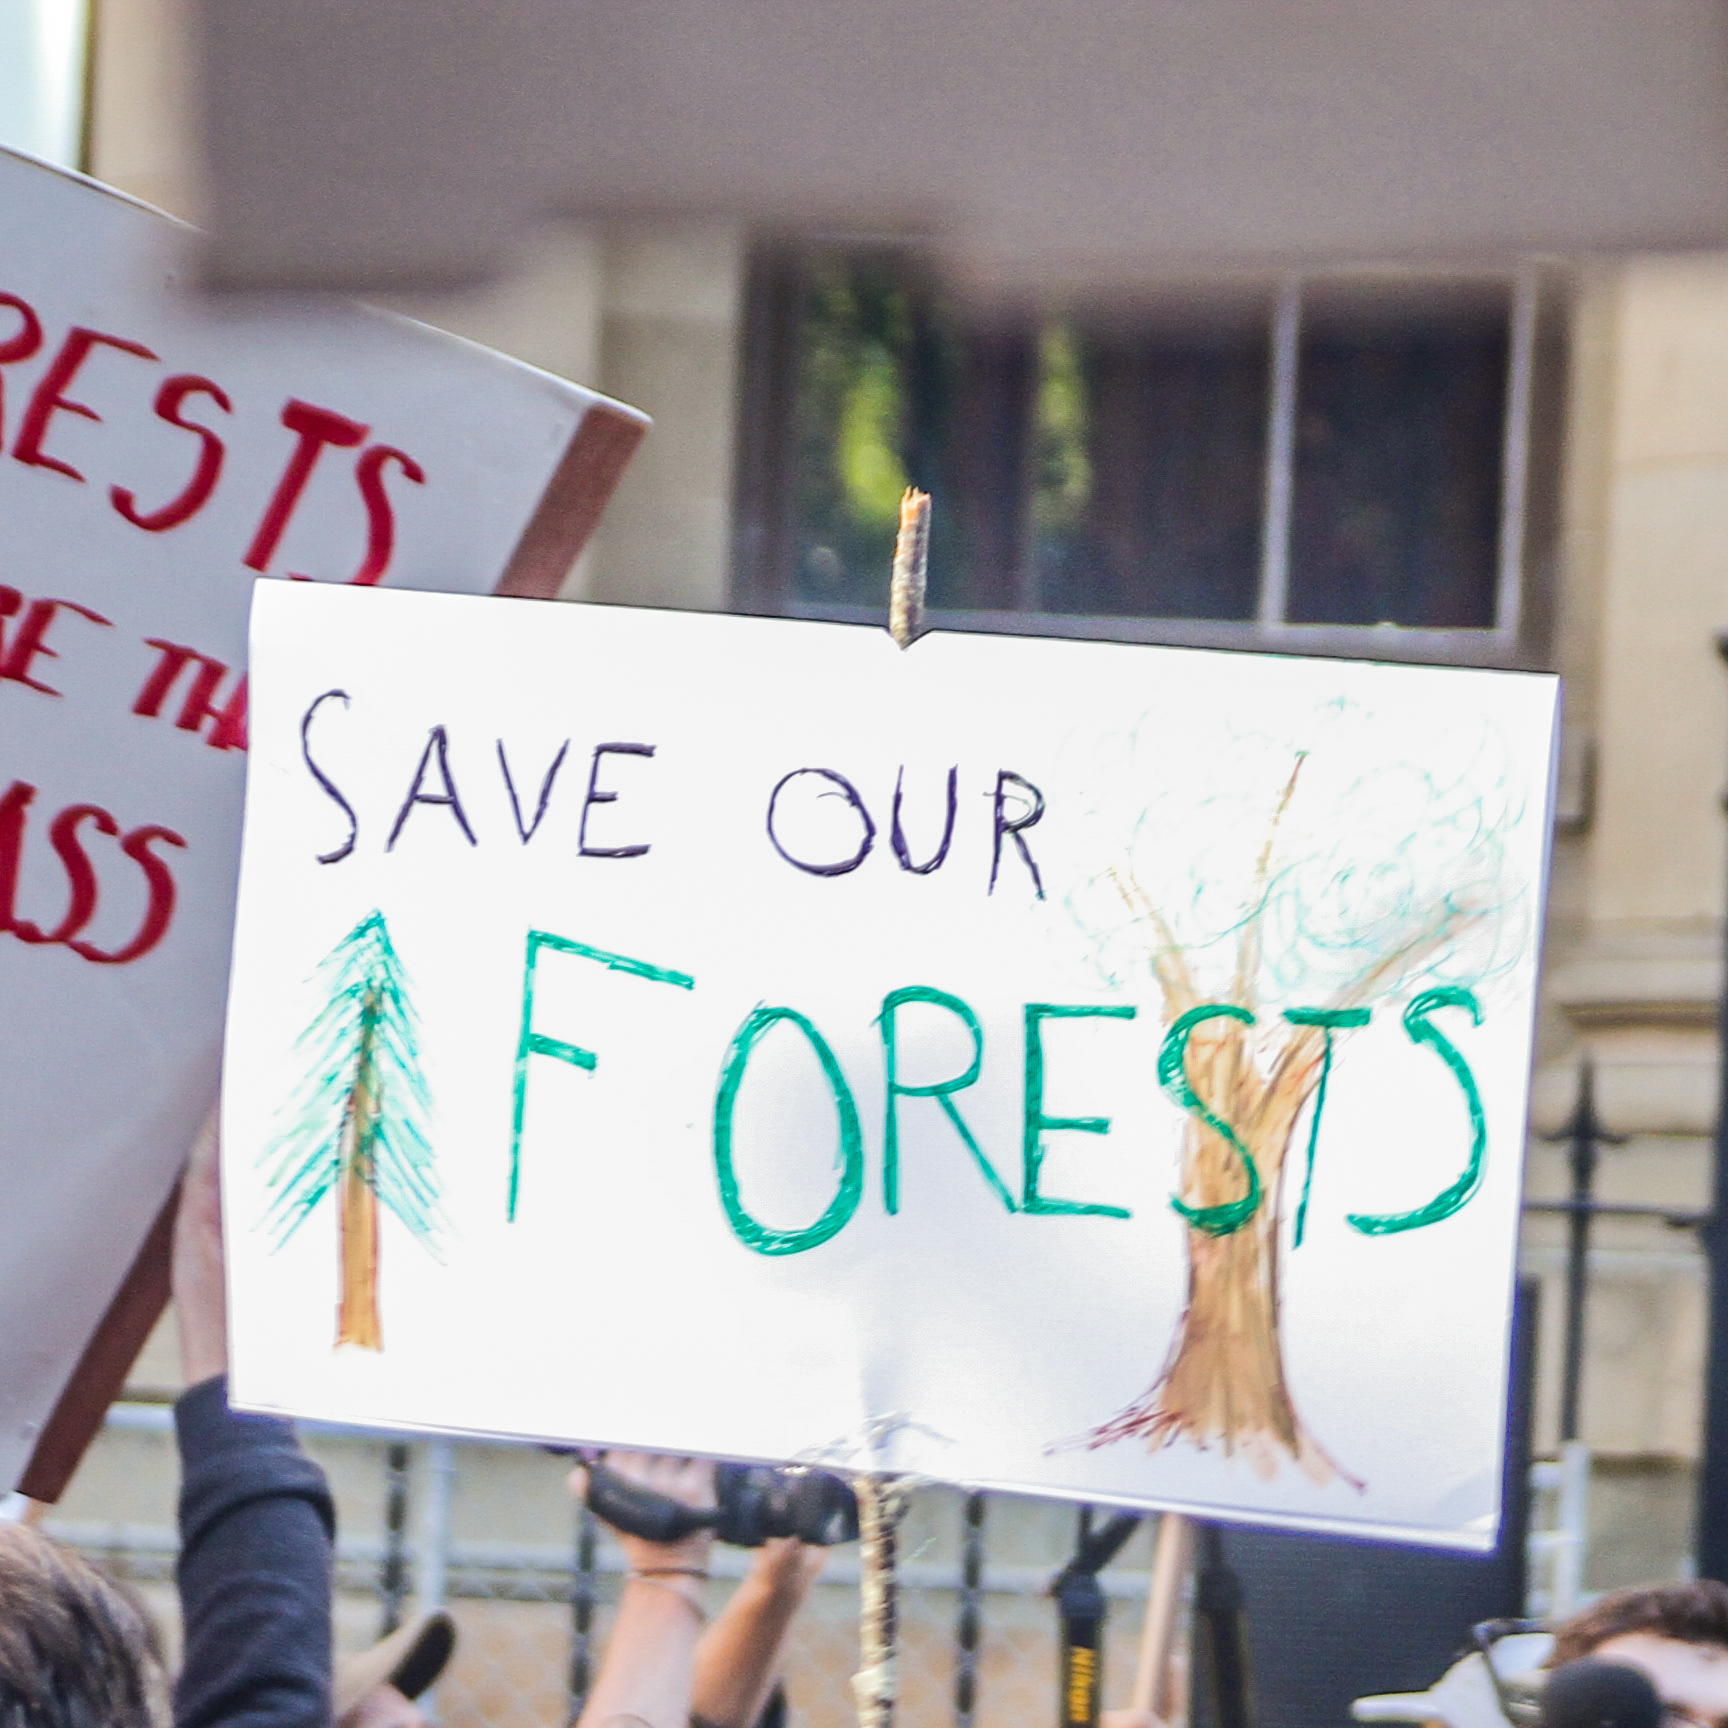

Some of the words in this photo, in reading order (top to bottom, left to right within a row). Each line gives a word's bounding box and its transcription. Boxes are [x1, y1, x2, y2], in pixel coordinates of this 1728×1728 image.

[132, 636, 249, 751] TH
[301, 688, 657, 865] SAVE
[766, 764, 1049, 903] OUR
[504, 928, 1490, 1257] FORESTS
